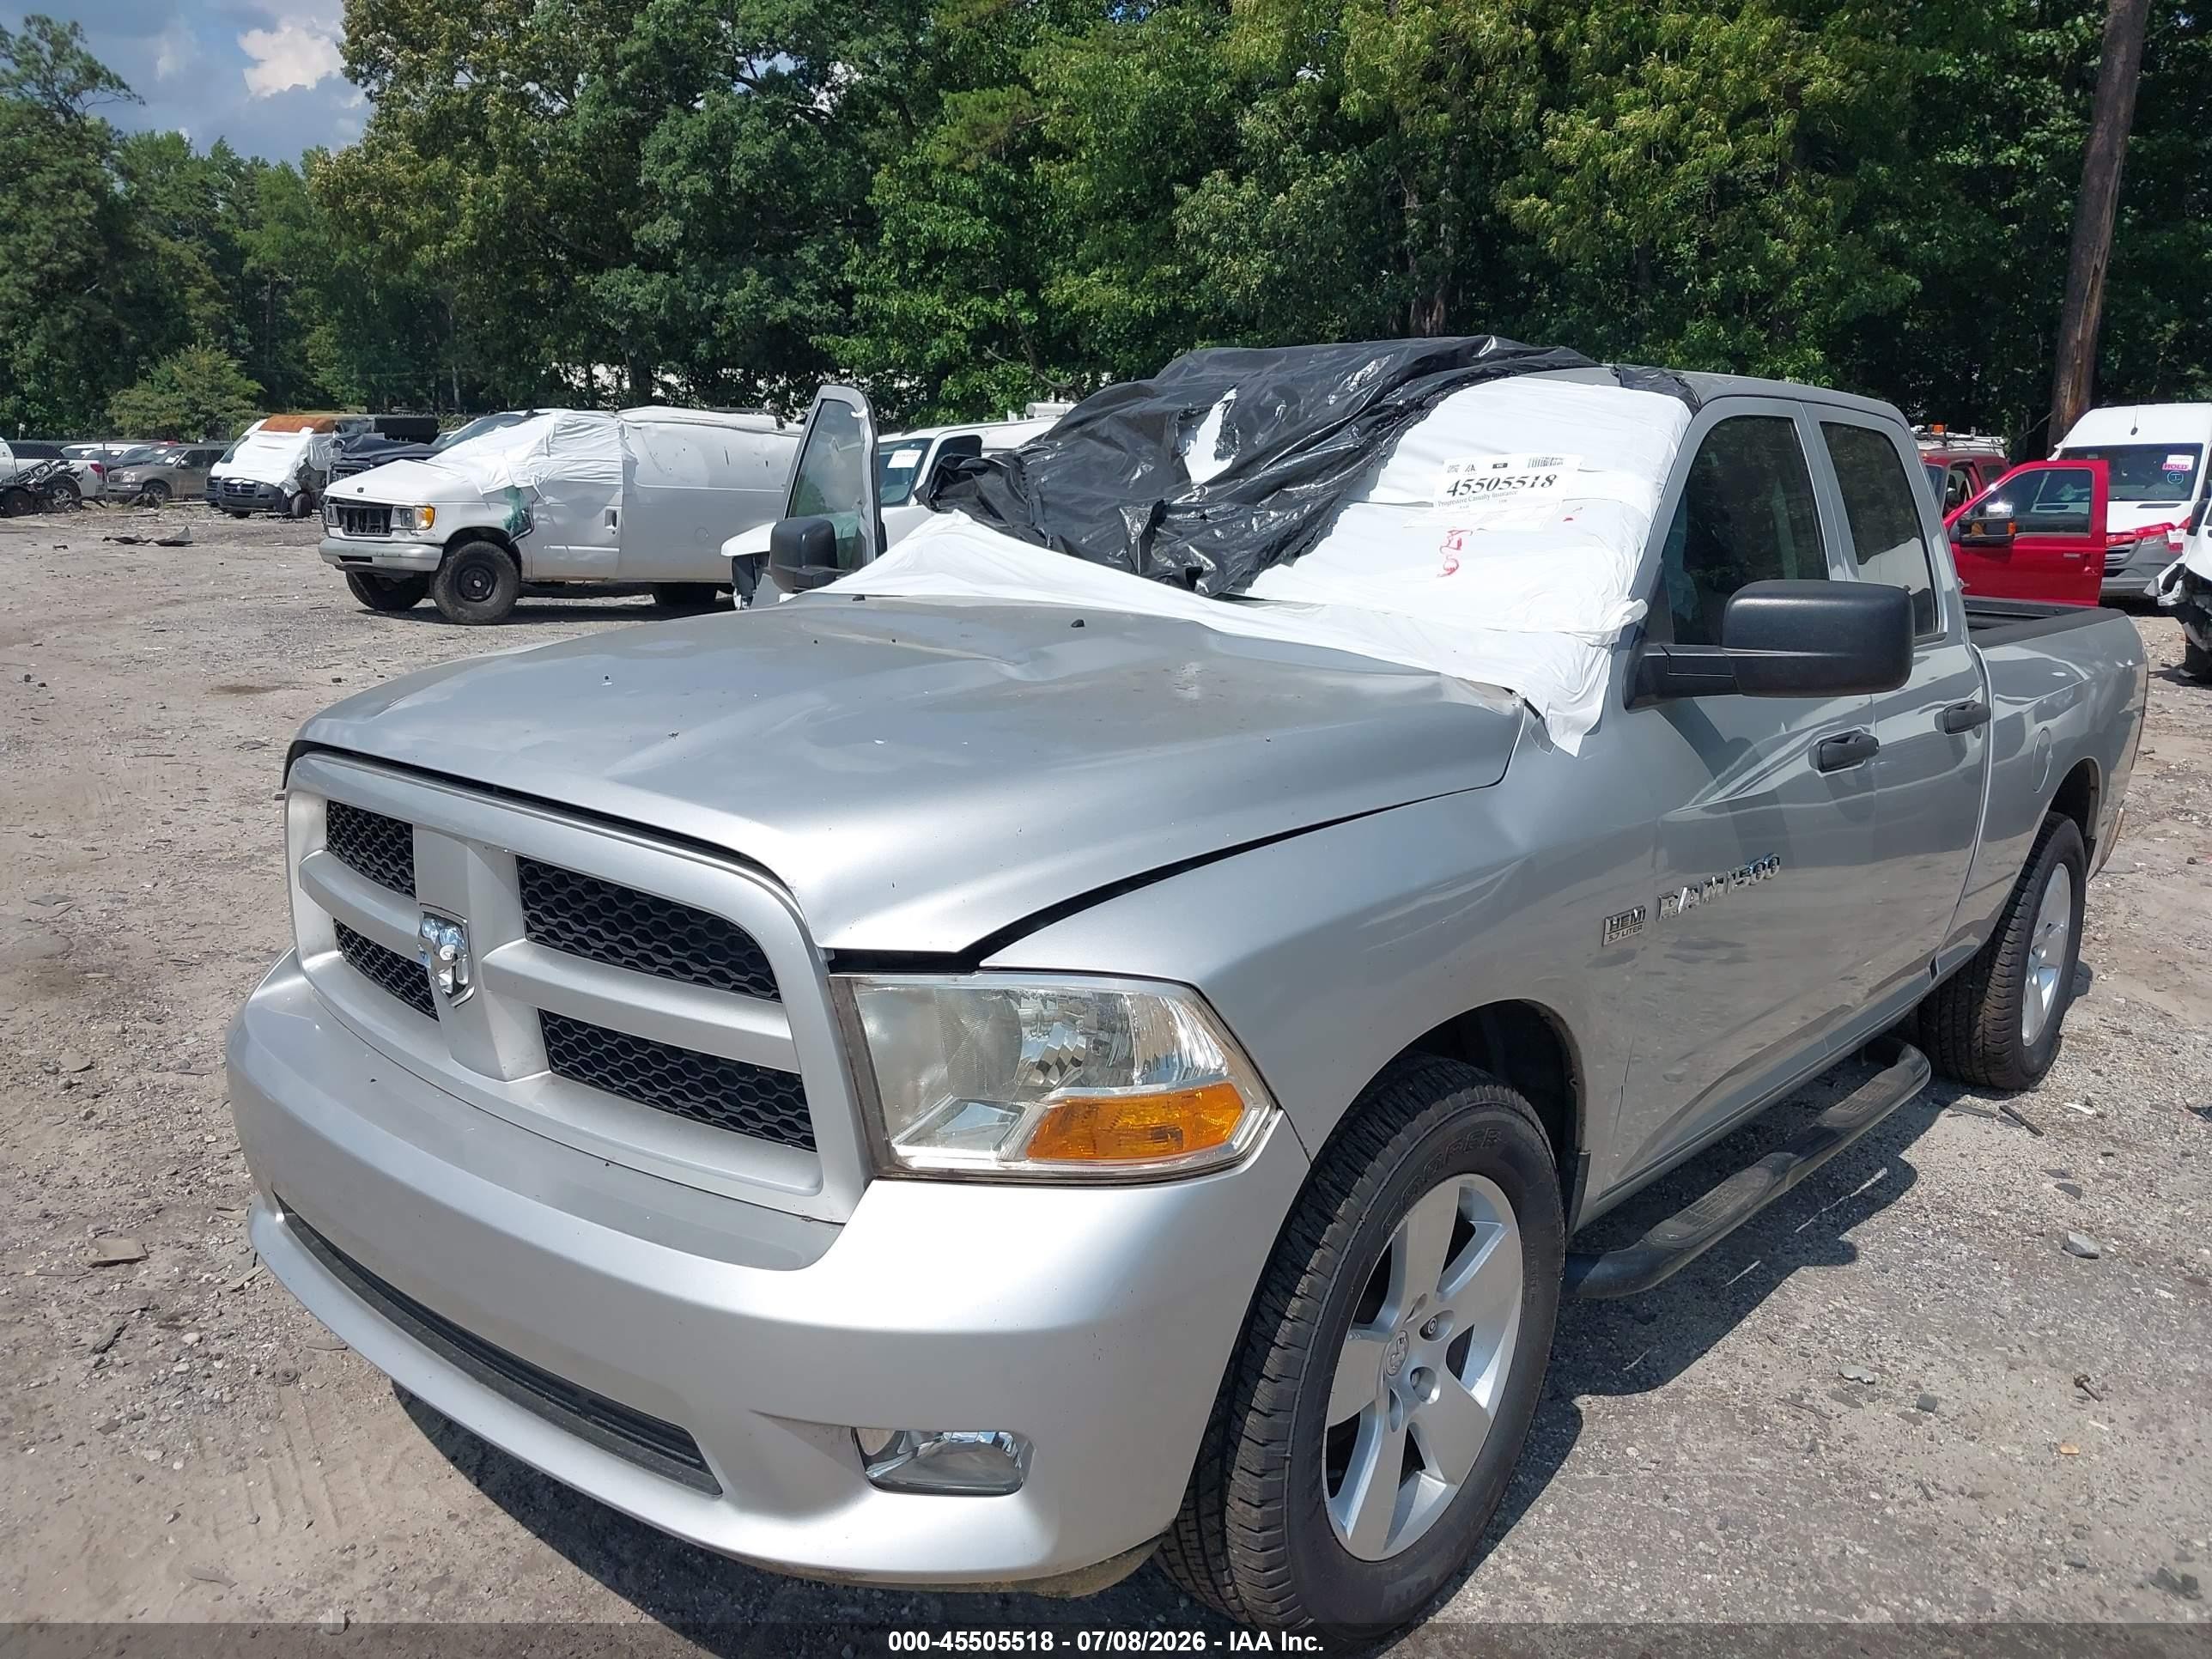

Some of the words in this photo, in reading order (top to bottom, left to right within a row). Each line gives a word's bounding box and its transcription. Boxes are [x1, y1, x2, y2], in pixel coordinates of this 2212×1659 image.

[1446, 474, 1558, 497] 45505518
[1656, 876, 1724, 921] RAM
[1725, 853, 1780, 895] 1500
[1607, 907, 1646, 932] HEMI
[1622, 924, 1643, 938] LITER
